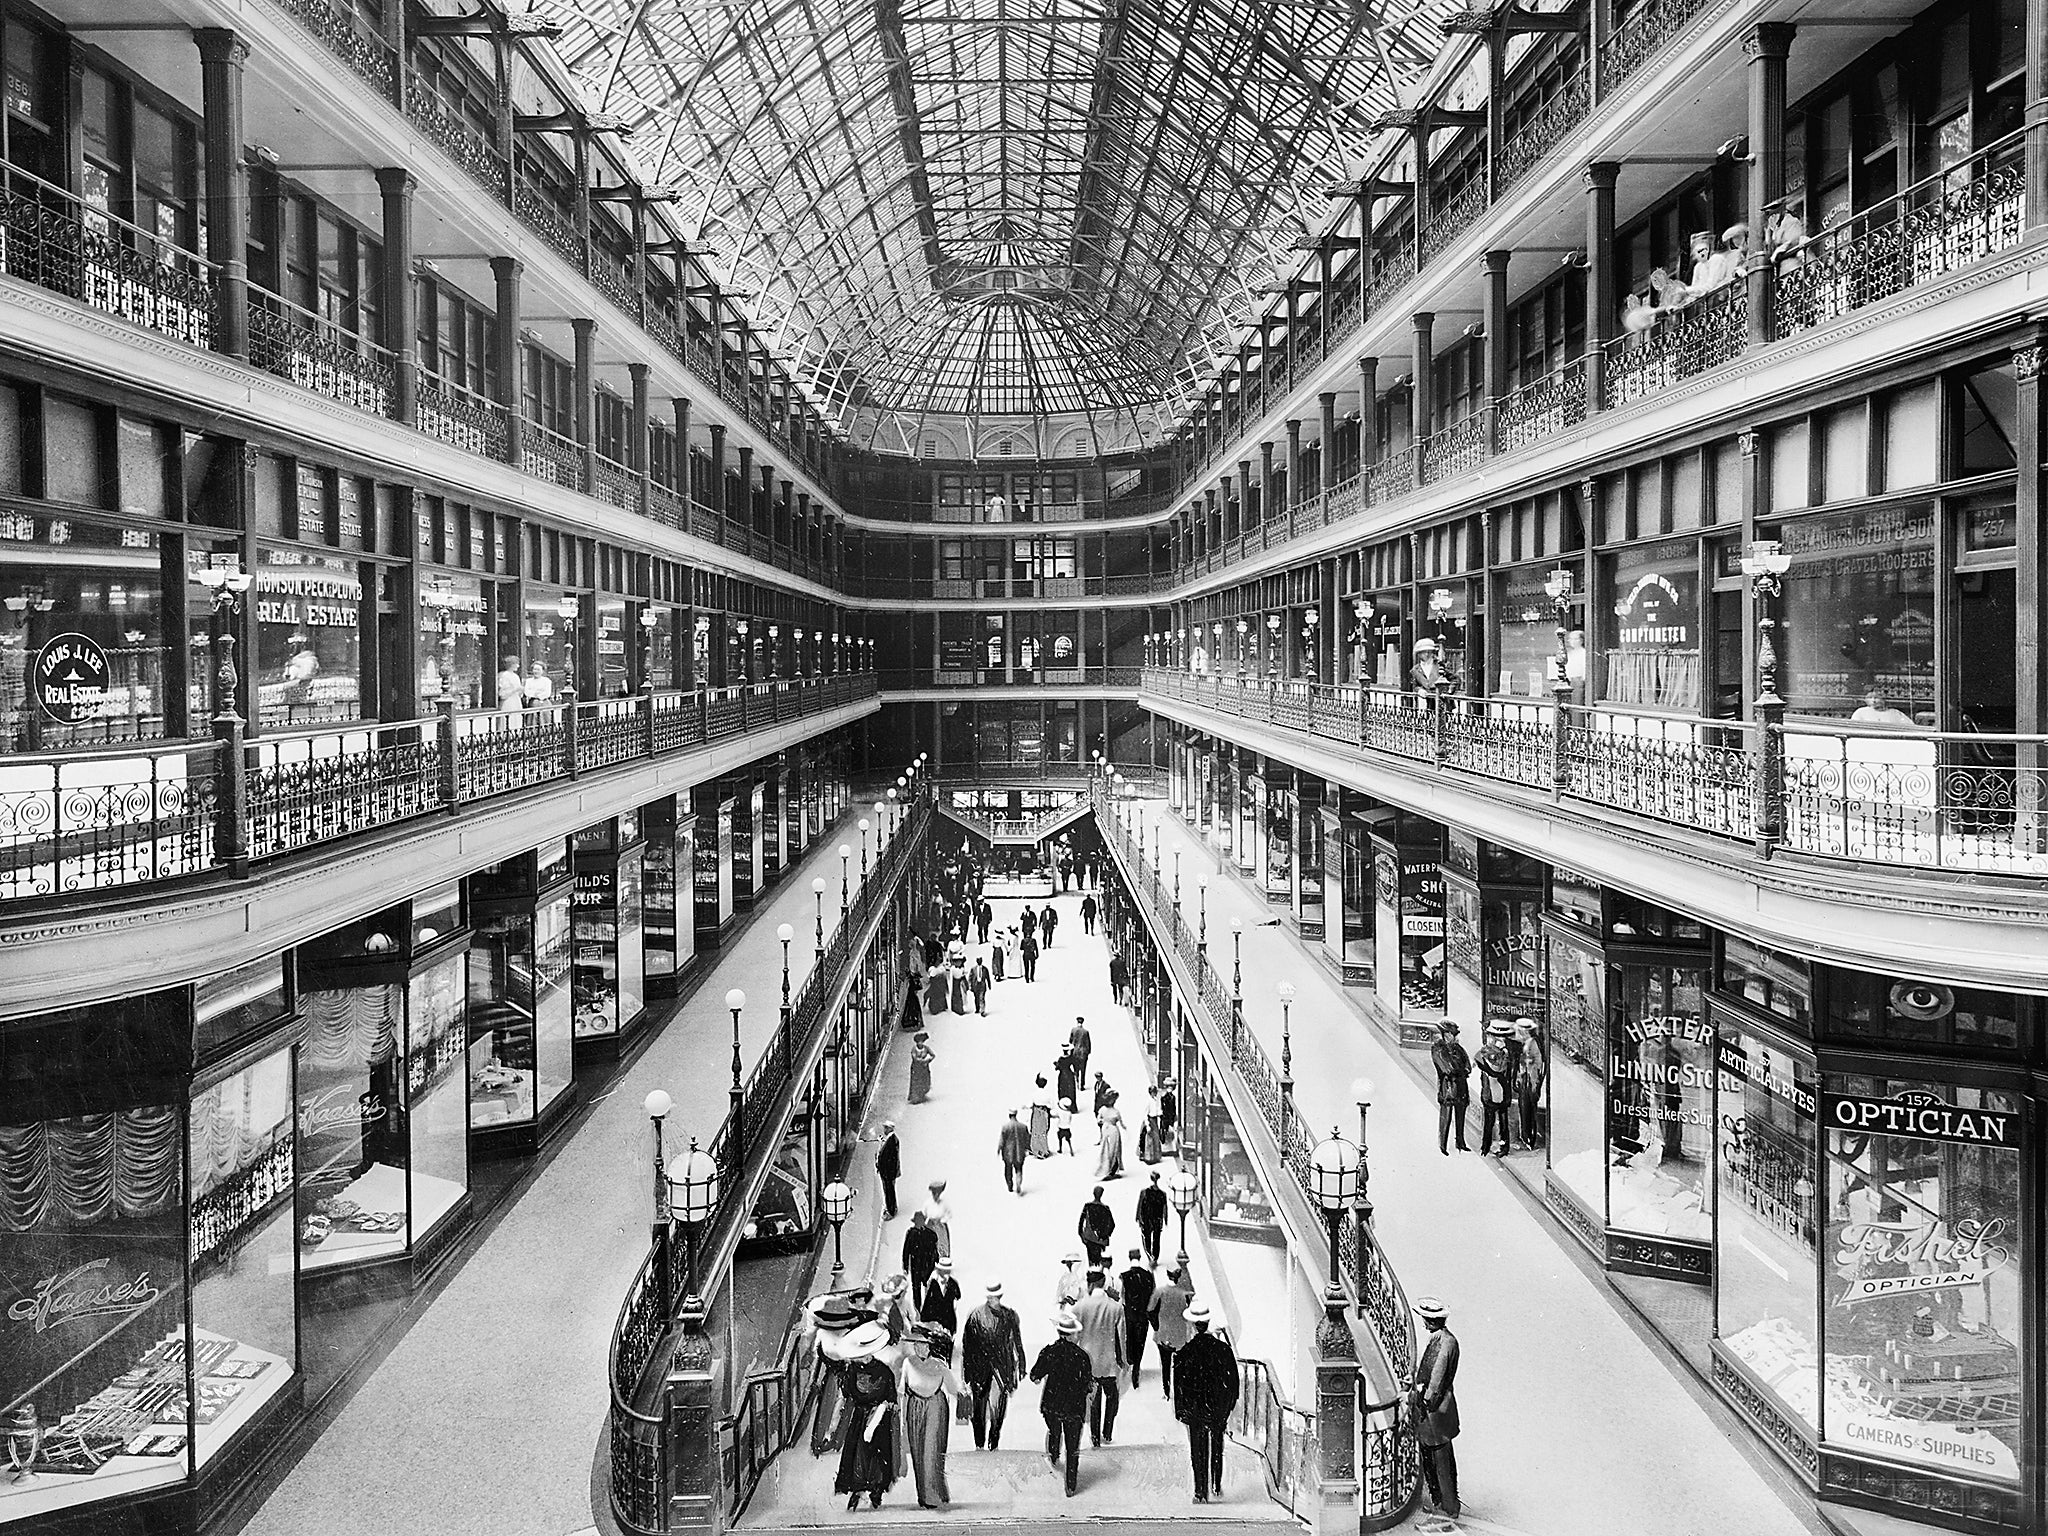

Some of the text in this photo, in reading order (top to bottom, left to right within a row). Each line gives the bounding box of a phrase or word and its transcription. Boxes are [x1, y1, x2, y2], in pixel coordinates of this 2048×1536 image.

[1982, 519, 2006, 537] 257
[1878, 550, 1935, 571] ROOFERS
[258, 601, 357, 627] REAL ESTATE
[1620, 626, 1686, 643] COMPTOMETER
[42, 643, 103, 676] LOUIS J. LEE
[45, 684, 70, 704] REAL
[1488, 966, 1536, 989] LINING
[1614, 1055, 1680, 1085] LINING
[1719, 1046, 1816, 1113] ARTIFICIAL EYES
[1907, 1094, 1932, 1107] 157
[1836, 1101, 2007, 1142] OPTICIAN
[1833, 1217, 2009, 1267] Fishel
[8, 1258, 158, 1333] Kaase's
[1863, 1272, 1975, 1293] OPTICIAN
[1846, 1422, 1913, 1449] CAMERAS
[1921, 1437, 1997, 1467] SUPPLIES
